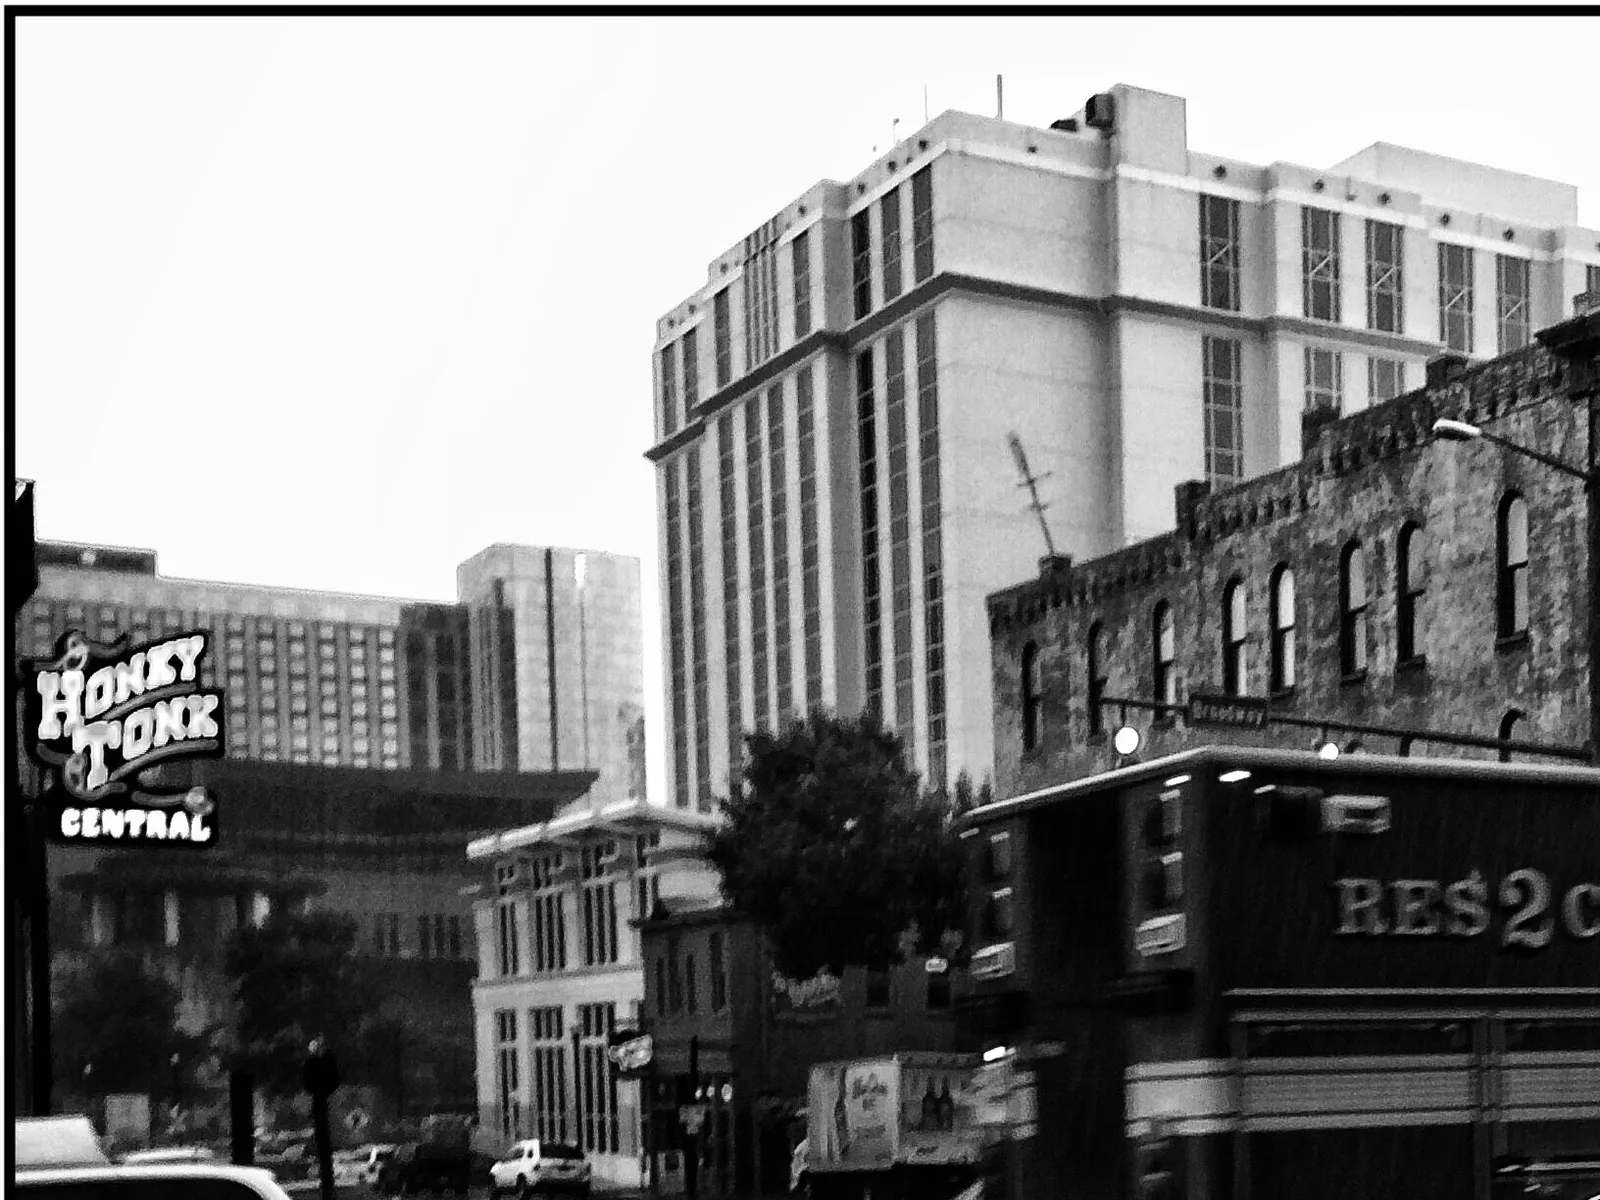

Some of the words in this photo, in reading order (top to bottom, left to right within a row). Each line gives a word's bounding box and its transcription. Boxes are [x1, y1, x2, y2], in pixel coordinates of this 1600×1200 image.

[37, 634, 204, 740] HONKY
[72, 694, 219, 791] TONK
[60, 807, 211, 842] CENTRAL
